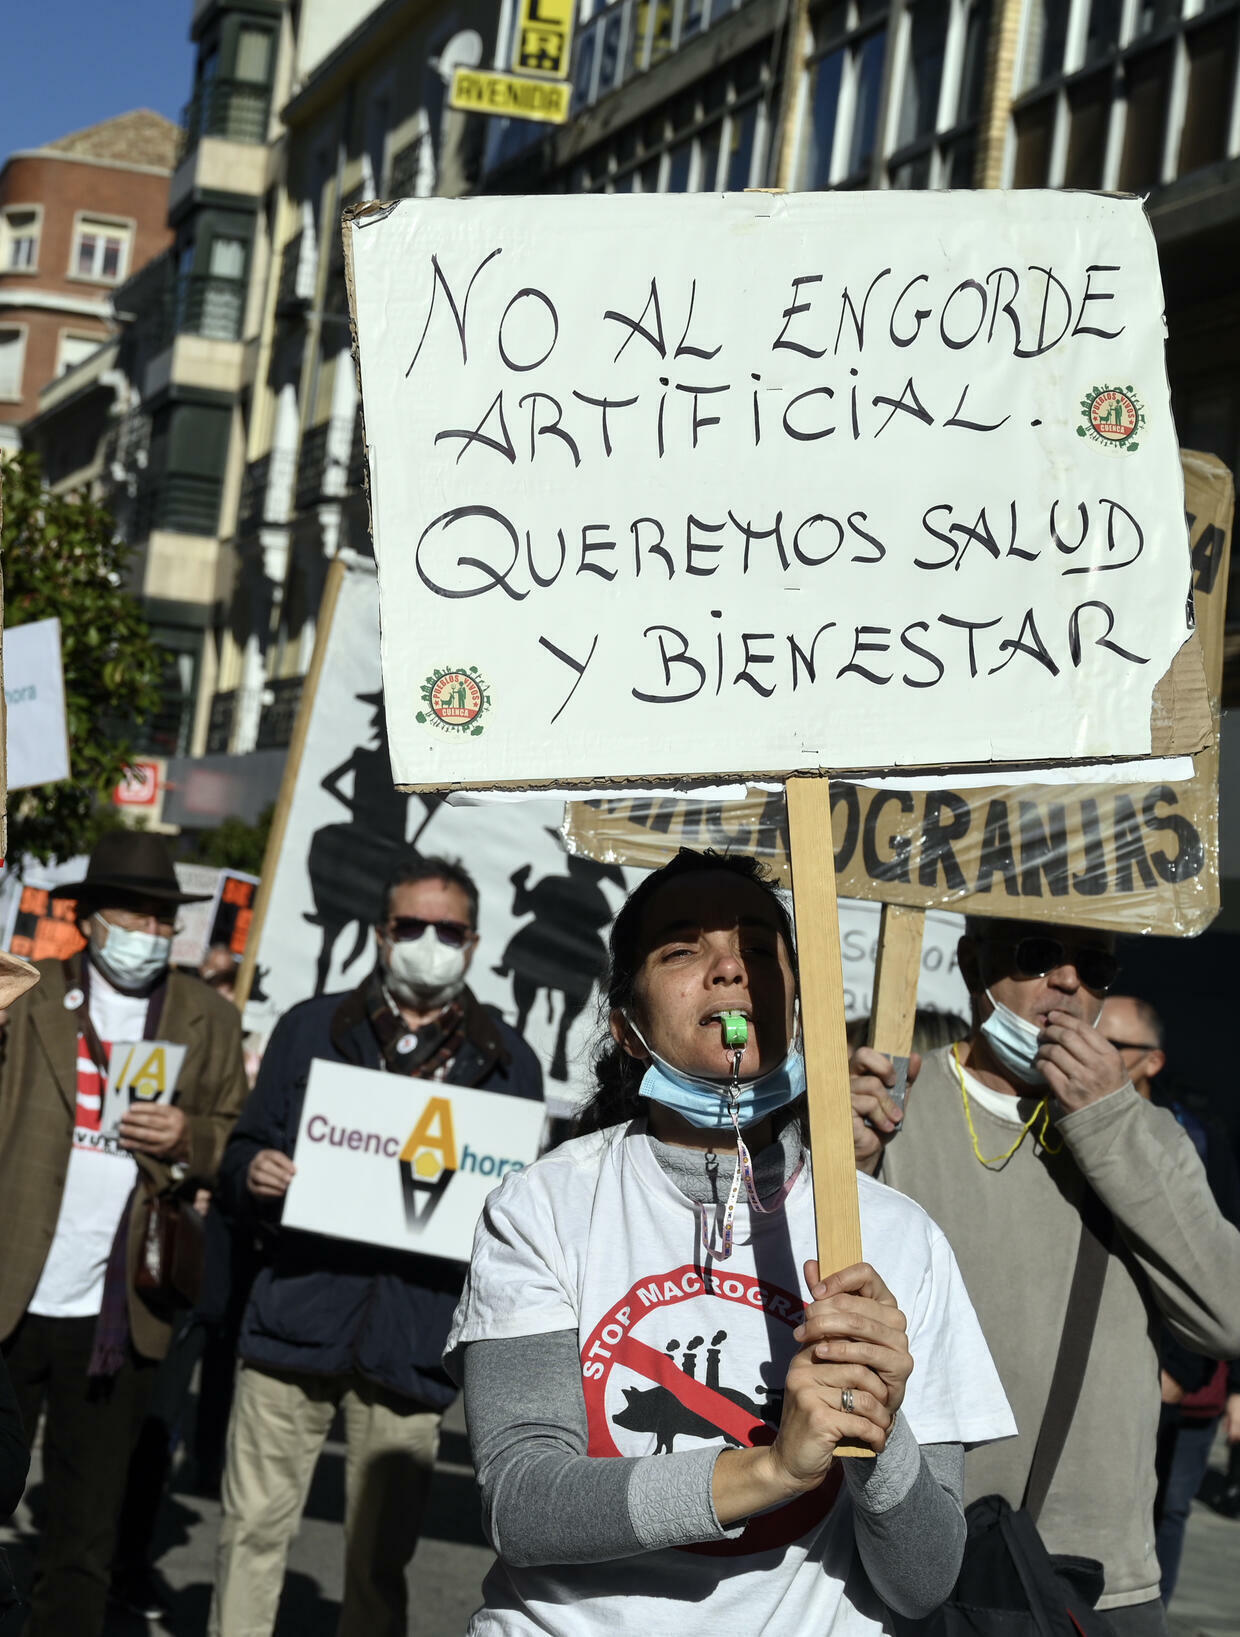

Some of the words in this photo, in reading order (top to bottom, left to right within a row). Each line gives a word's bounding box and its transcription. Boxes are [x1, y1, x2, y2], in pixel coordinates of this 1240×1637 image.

[406, 248, 559, 377] NO
[604, 277, 723, 363] AL
[772, 264, 1127, 359] ENGORDE
[1092, 392, 1116, 415] PUEBLOS
[1120, 396, 1135, 419] VIVOS
[1100, 424, 1126, 433] CUENCA
[415, 505, 888, 601] QUEREMOS
[914, 499, 1145, 578] SALUD
[433, 675, 460, 699] PUEBLOS
[463, 677, 480, 701] VIVOS
[538, 634, 600, 724] Y
[441, 708, 469, 717] CUENCA
[582, 1306, 633, 1381] STOP
